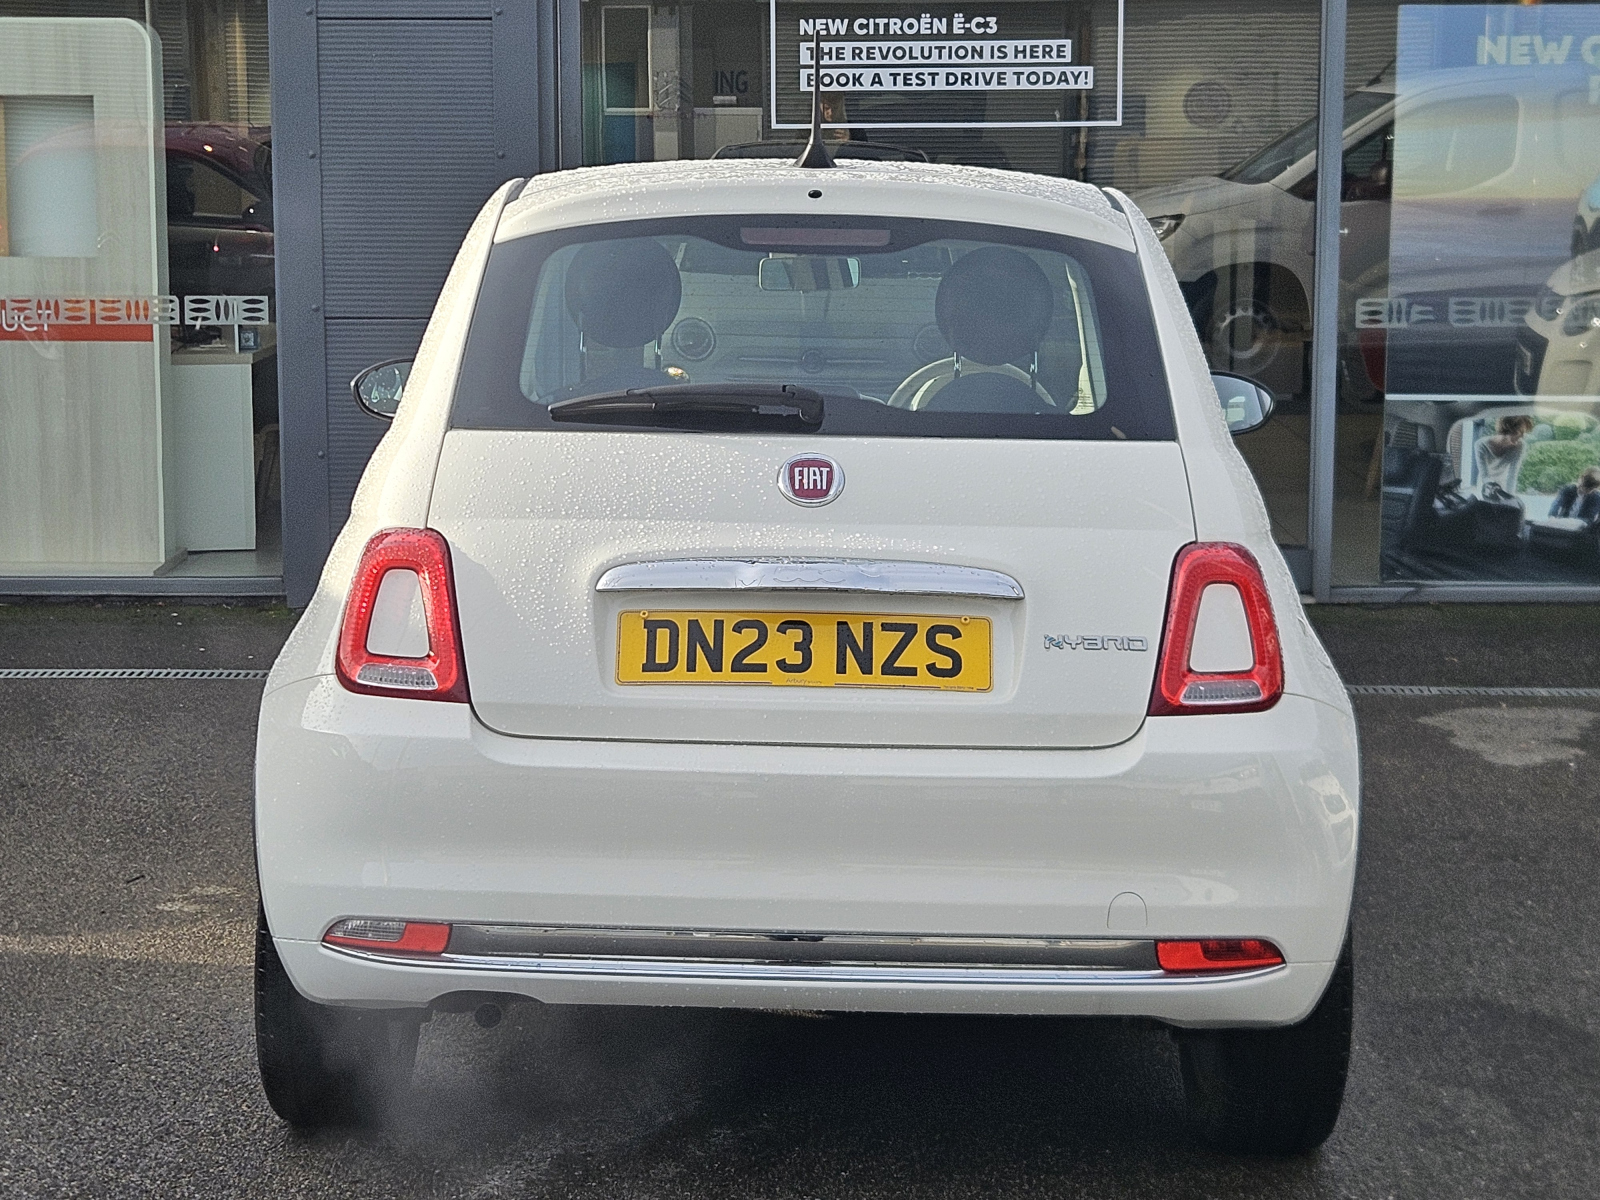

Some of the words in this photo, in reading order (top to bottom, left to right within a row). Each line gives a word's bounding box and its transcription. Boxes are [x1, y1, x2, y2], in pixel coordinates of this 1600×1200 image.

[800, 18, 849, 36] NEW
[853, 13, 947, 35] CITROËN
[952, 13, 998, 34] Ë-C3
[806, 46, 846, 61] THE
[851, 45, 984, 61] REVOLUTION
[990, 44, 1008, 60] IS
[1013, 44, 1067, 60] HERE
[1475, 34, 1574, 66] NEW
[870, 72, 884, 87] A
[889, 72, 940, 87] TEST
[945, 71, 1007, 87] DRIVE
[1012, 70, 1089, 86] TODAY!
[794, 467, 830, 490] FIAT
[641, 618, 813, 674] DN23
[836, 620, 963, 678] NZS
